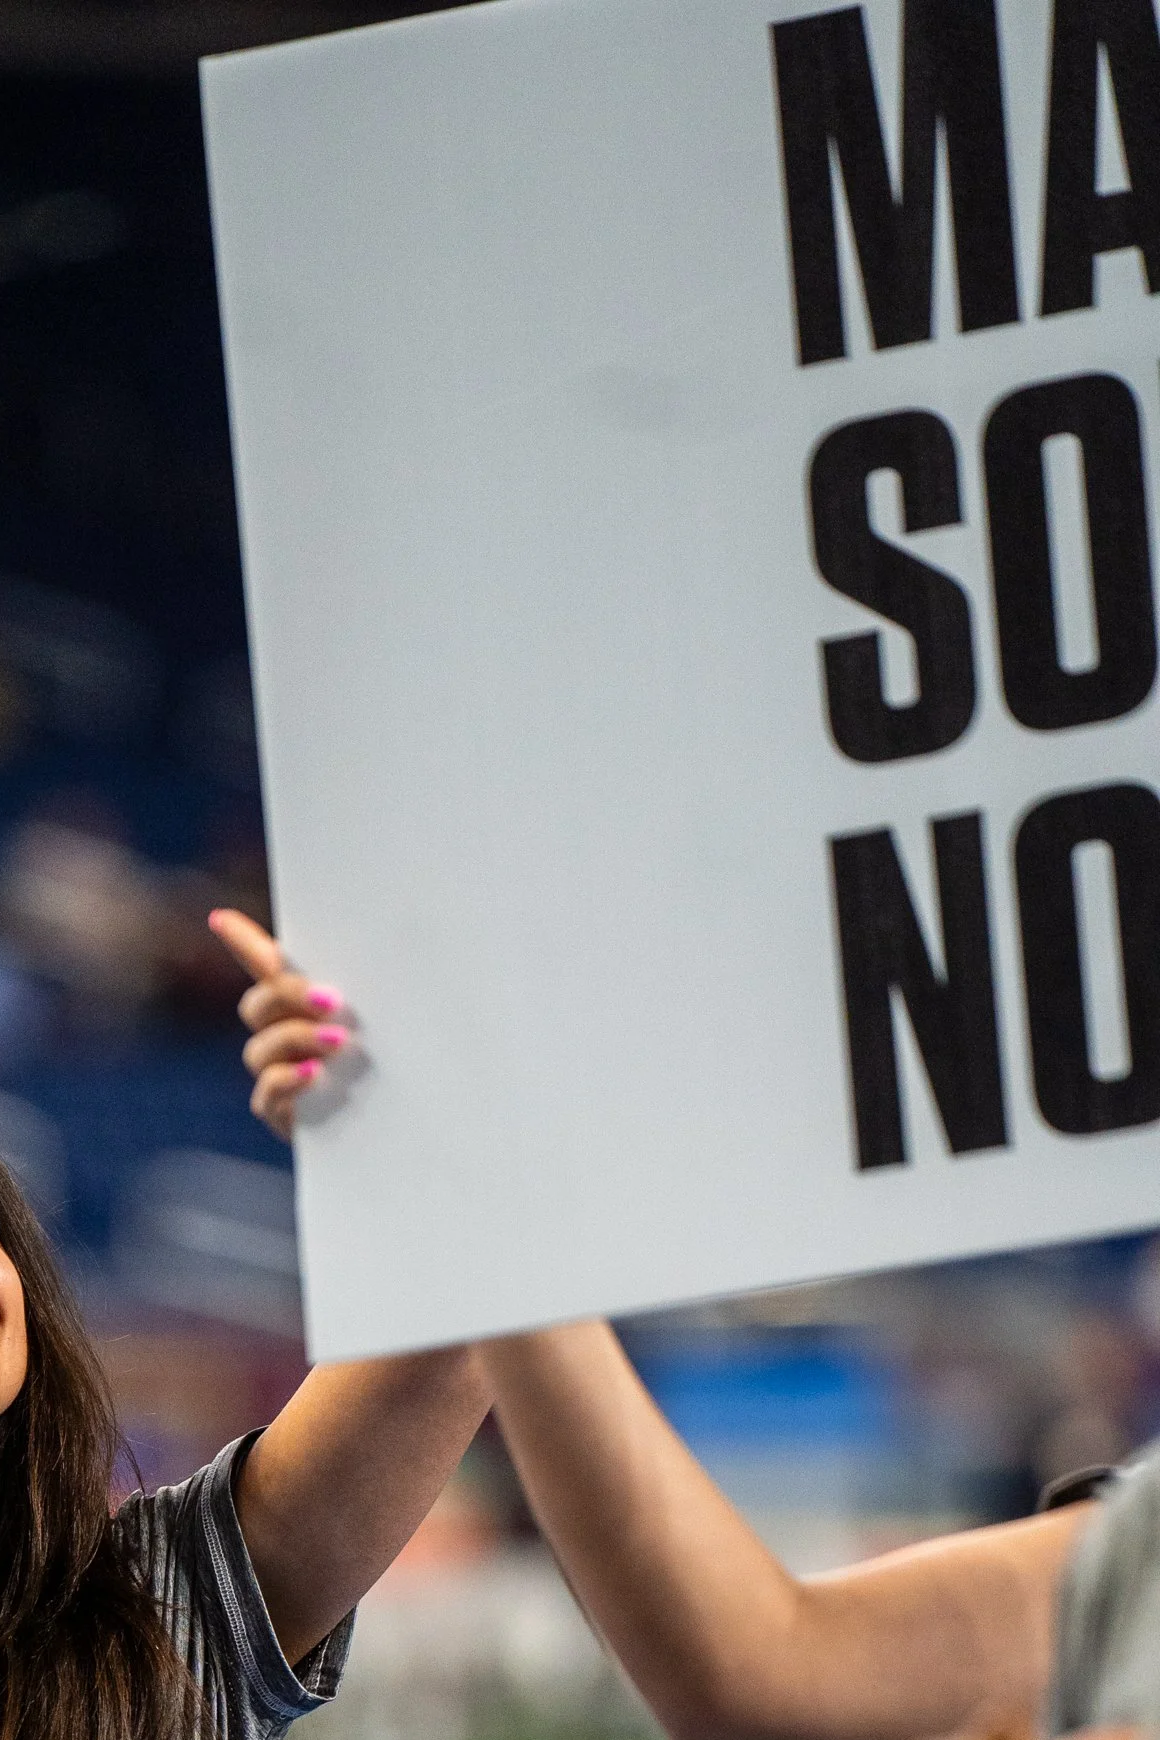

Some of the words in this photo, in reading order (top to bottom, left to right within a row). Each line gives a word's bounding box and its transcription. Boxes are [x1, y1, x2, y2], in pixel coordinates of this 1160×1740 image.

[768, 0, 1160, 369] MA
[804, 358, 1160, 766] SO
[825, 777, 1160, 1173] NO
